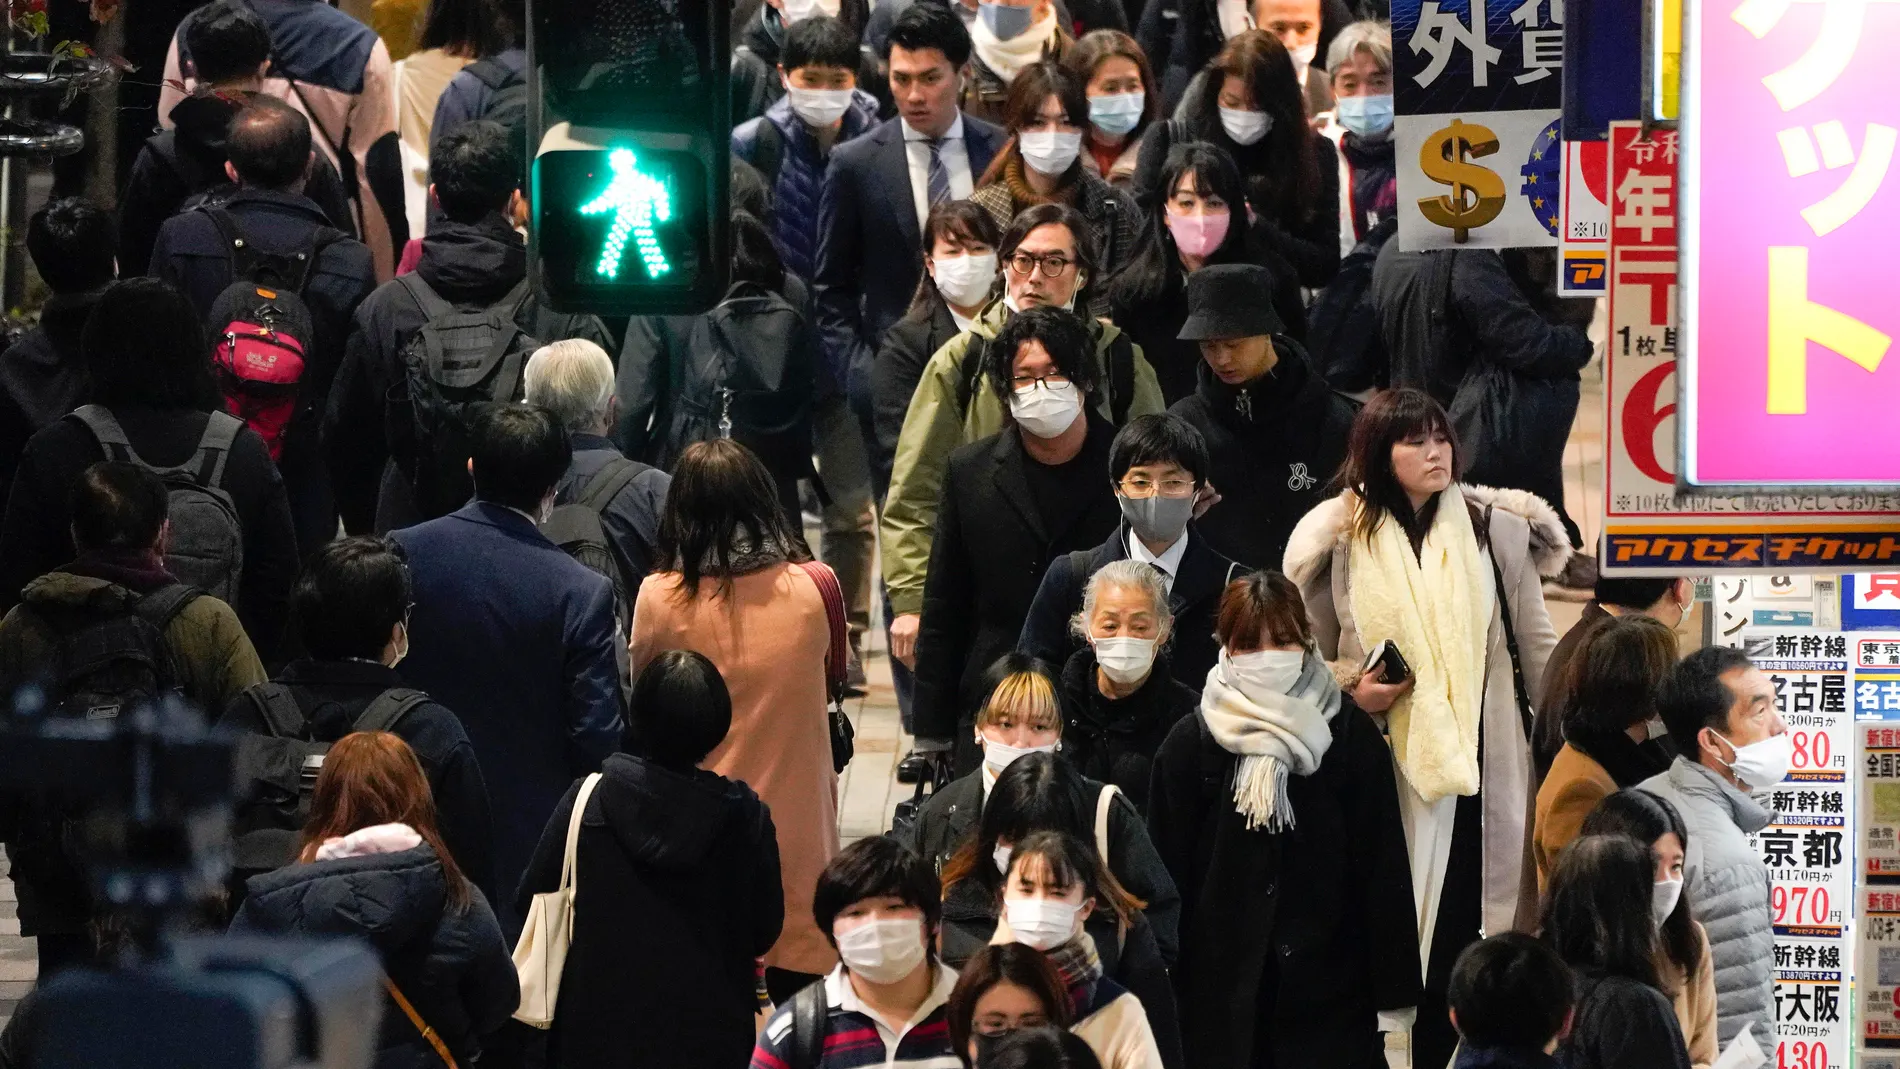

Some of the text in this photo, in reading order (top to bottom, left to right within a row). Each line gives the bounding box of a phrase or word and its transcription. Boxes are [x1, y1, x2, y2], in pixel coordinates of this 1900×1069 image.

[1775, 635, 1847, 658] 新幹線
[1770, 674, 1846, 713] 名古屋
[1784, 731, 1845, 769] 80円
[1772, 791, 1843, 813] 新幹線
[1759, 829, 1843, 868] 京都
[1773, 944, 1841, 968] 新幹線
